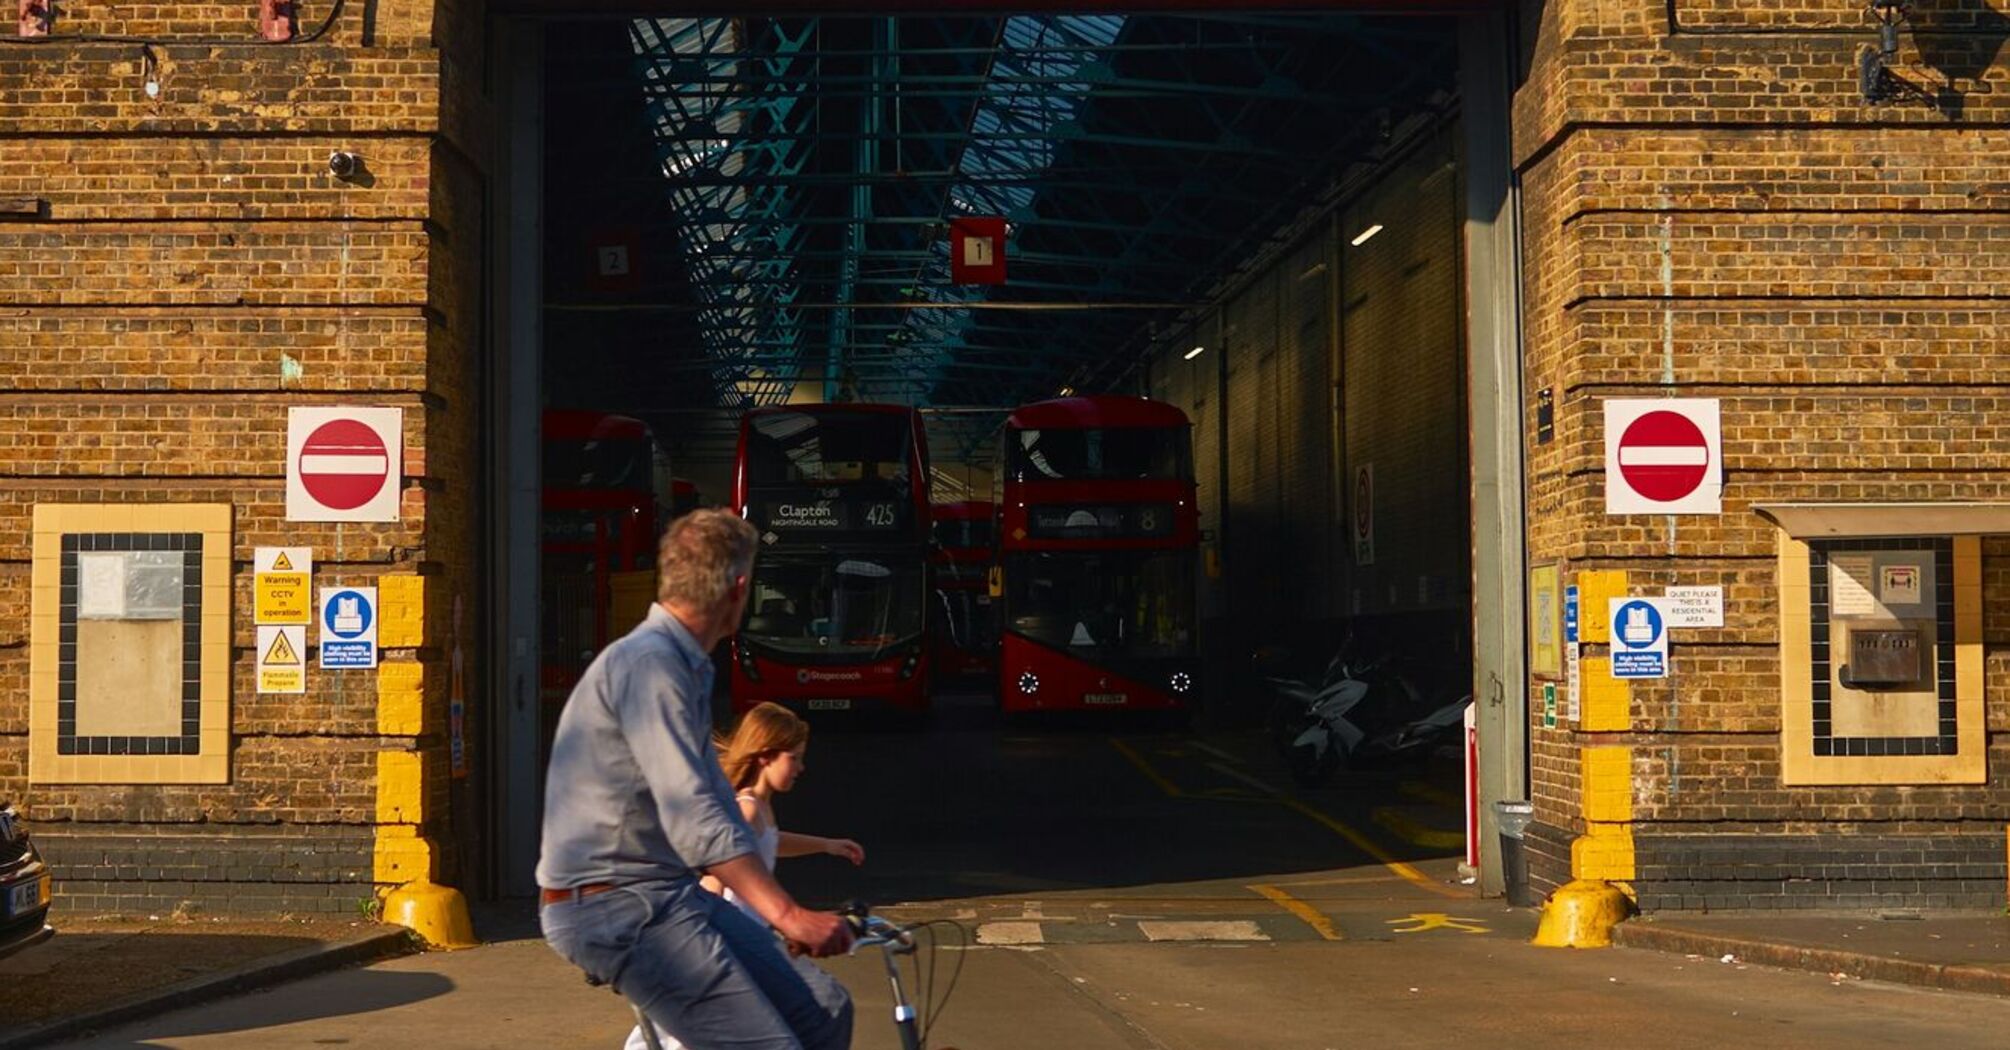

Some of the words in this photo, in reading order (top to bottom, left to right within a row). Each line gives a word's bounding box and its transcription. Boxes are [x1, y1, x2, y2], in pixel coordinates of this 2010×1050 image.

[976, 243, 983, 260] 1
[608, 251, 619, 269] 2
[778, 504, 831, 519] Clapton
[865, 504, 895, 526] 425
[771, 519, 817, 527] NIGHTINGALE
[818, 519, 839, 527] ROAD
[1141, 510, 1156, 531] 8
[264, 576, 301, 586] Warning
[1670, 590, 1691, 598] QUIET
[1692, 590, 1717, 598] PLEASE
[264, 609, 302, 617] operation
[1671, 607, 1717, 615] RESIDENTIAL
[1685, 615, 1705, 623] AREA
[1616, 661, 1638, 669] clothing
[811, 670, 863, 682] Stagecoach
